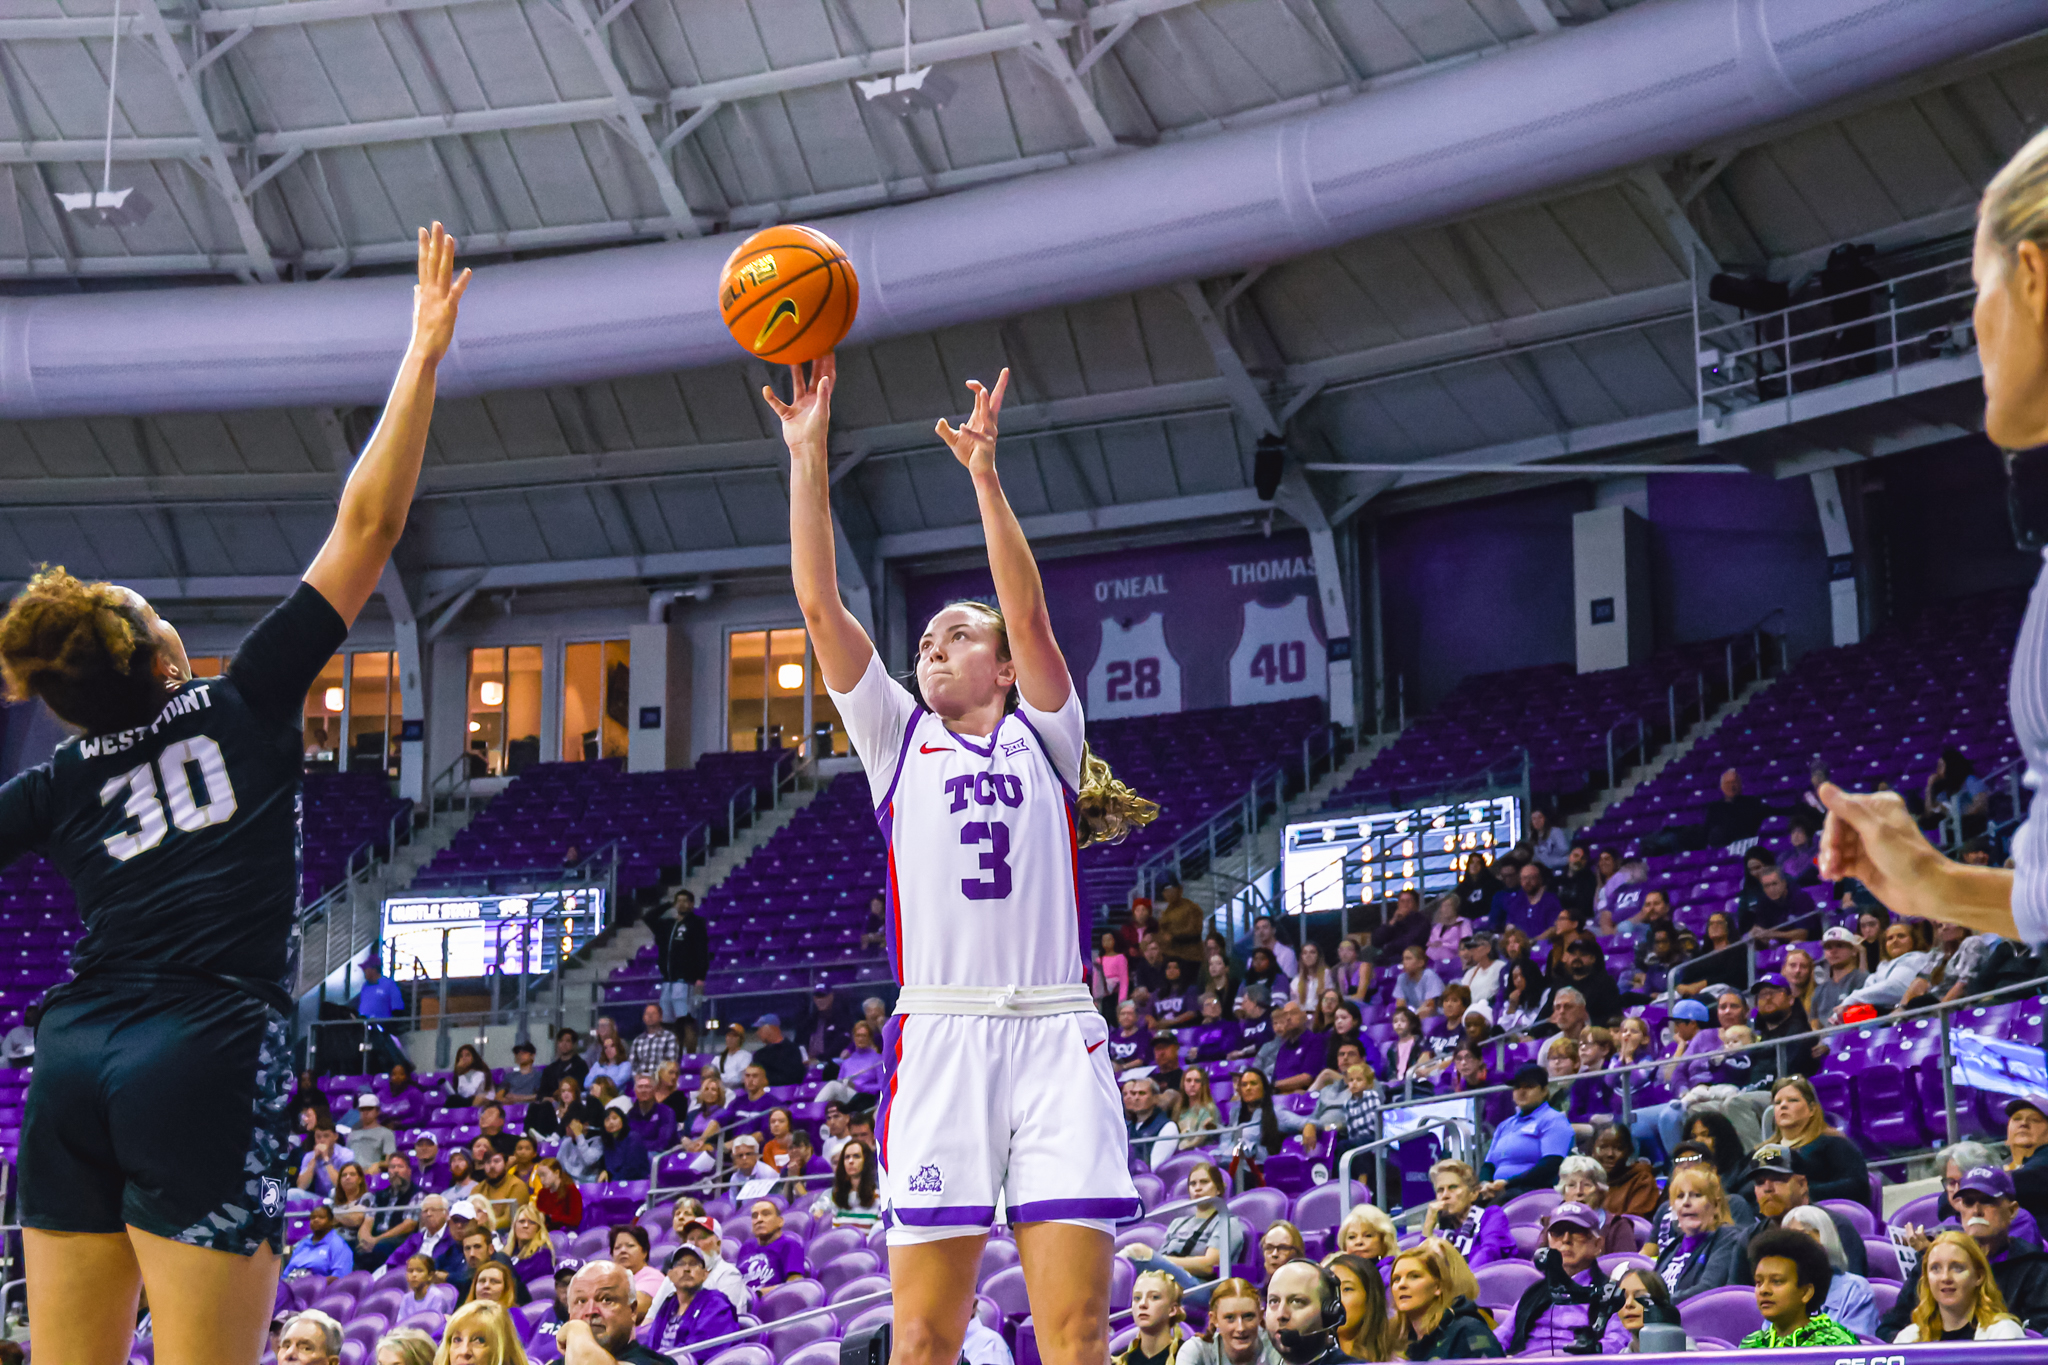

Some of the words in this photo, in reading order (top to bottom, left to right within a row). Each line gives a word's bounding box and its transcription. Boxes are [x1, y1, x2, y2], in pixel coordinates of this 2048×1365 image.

[1094, 573, 1169, 602] O'NEAL
[1228, 556, 1318, 586] THOMAS
[1106, 657, 1161, 702] 28
[1250, 640, 1307, 686] 40
[80, 726, 149, 760] WEST
[99, 734, 239, 862] 30
[944, 771, 1025, 815] TCU
[960, 820, 1013, 901] 3
